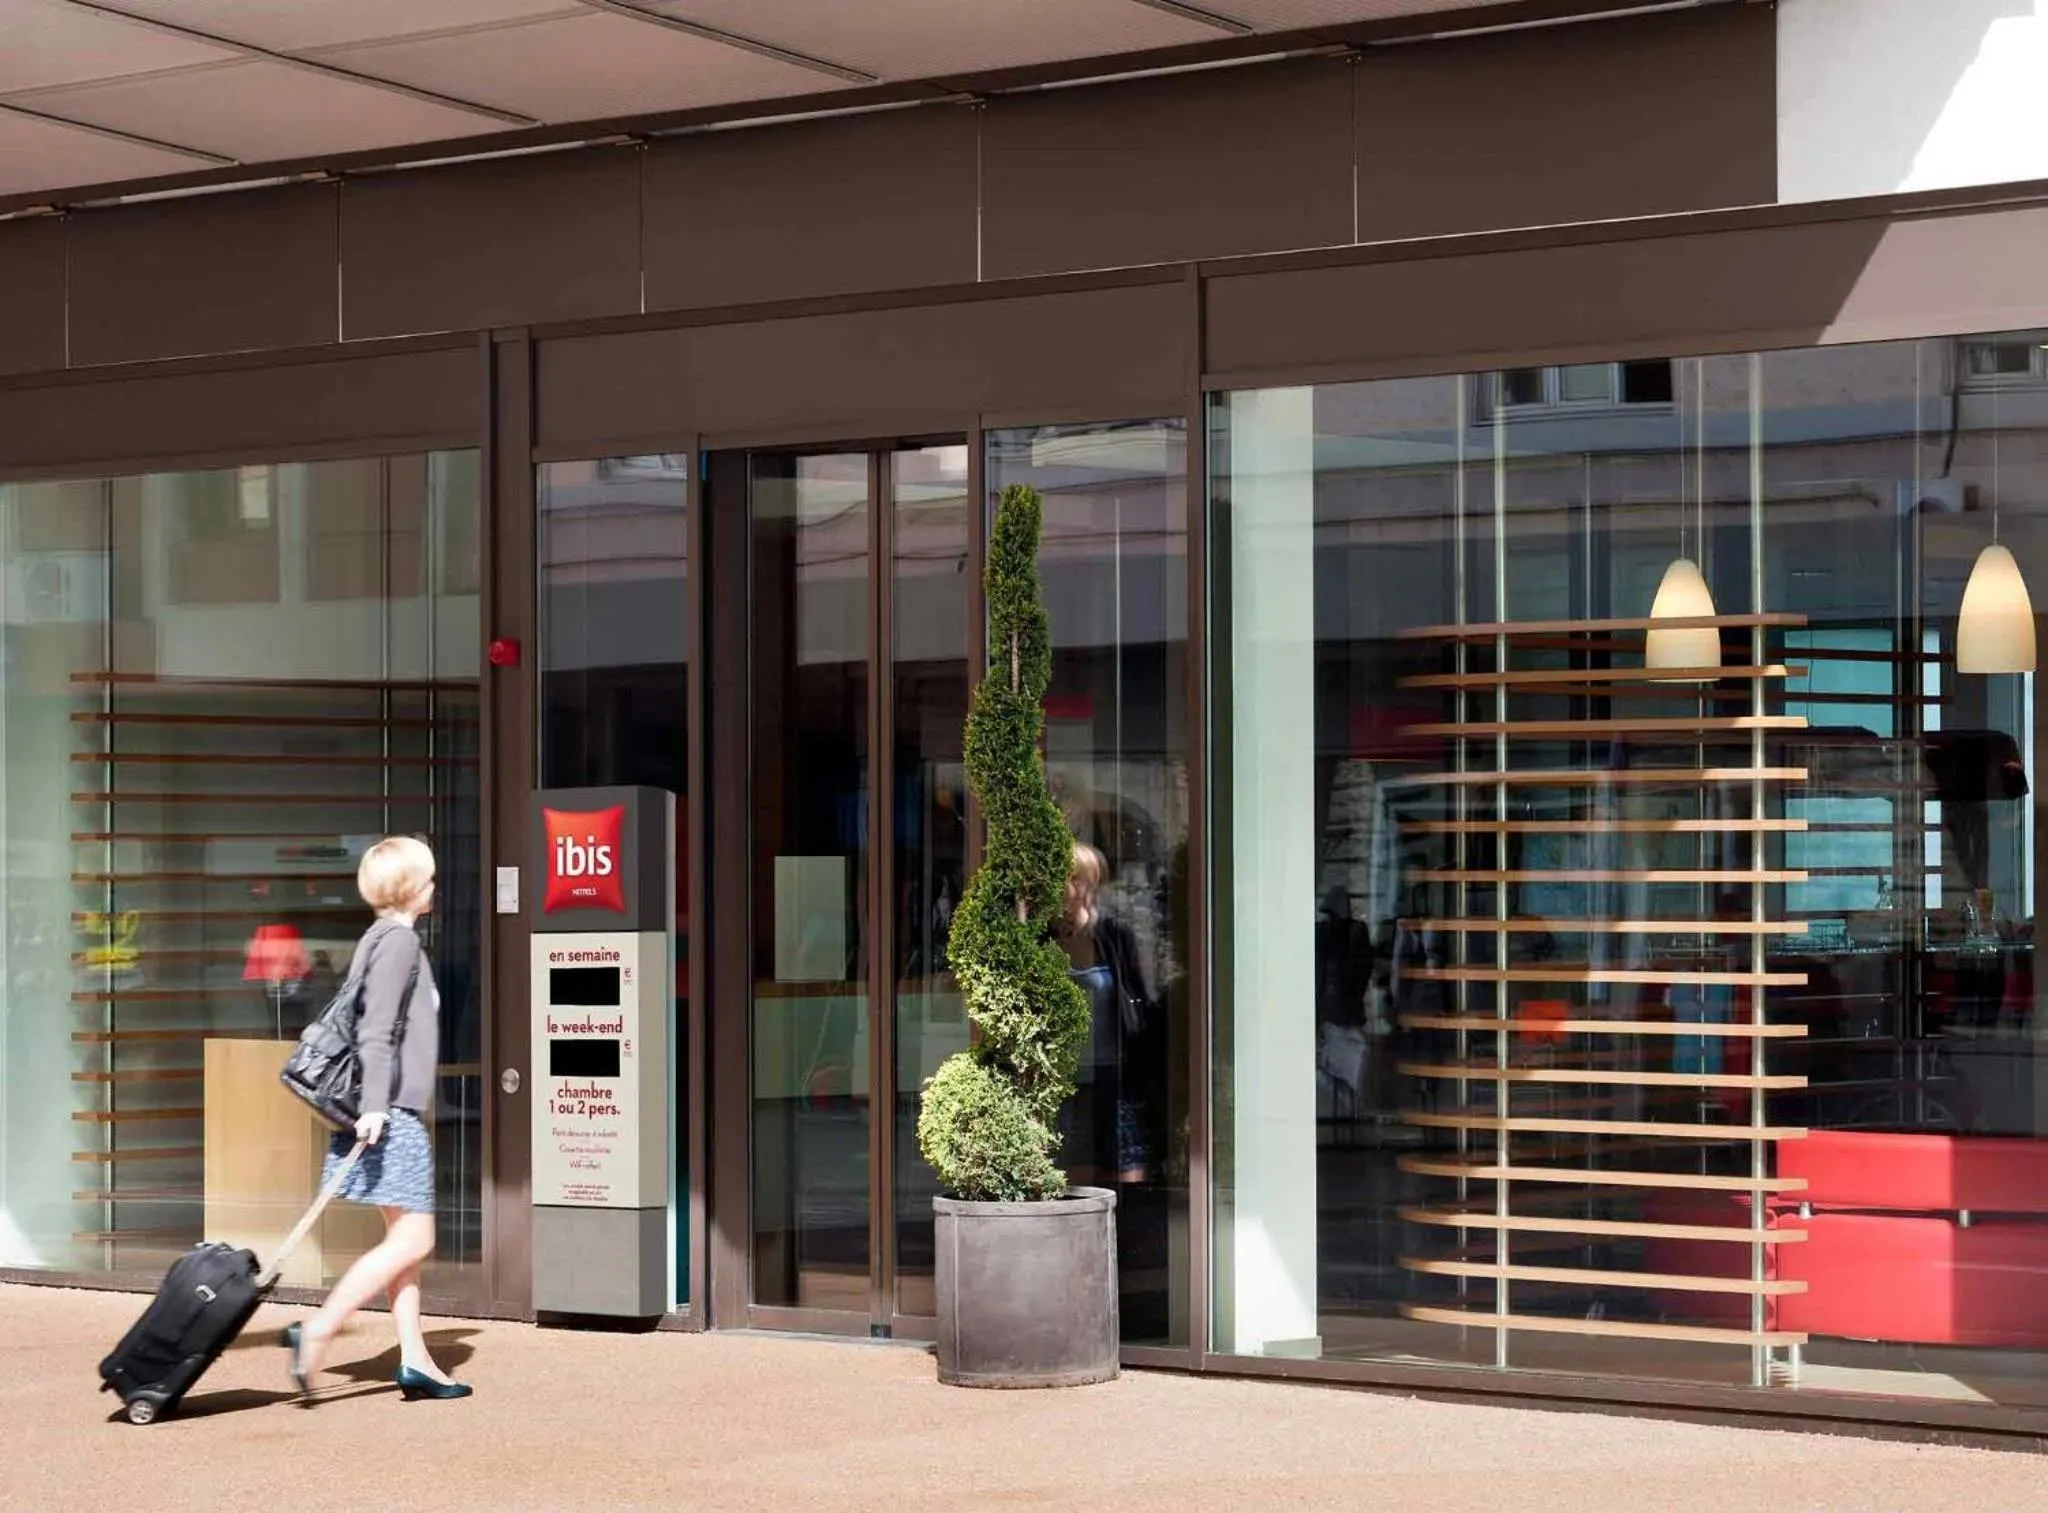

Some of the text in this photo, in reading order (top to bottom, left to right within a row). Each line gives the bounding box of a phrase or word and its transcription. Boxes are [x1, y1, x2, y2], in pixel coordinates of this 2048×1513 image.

[556, 835, 612, 876] ibis
[549, 946, 621, 962] en semaine
[547, 1014, 623, 1034] le week-end
[557, 1079, 613, 1099] chambre
[549, 1099, 621, 1120] 1 ou 2 pers.
